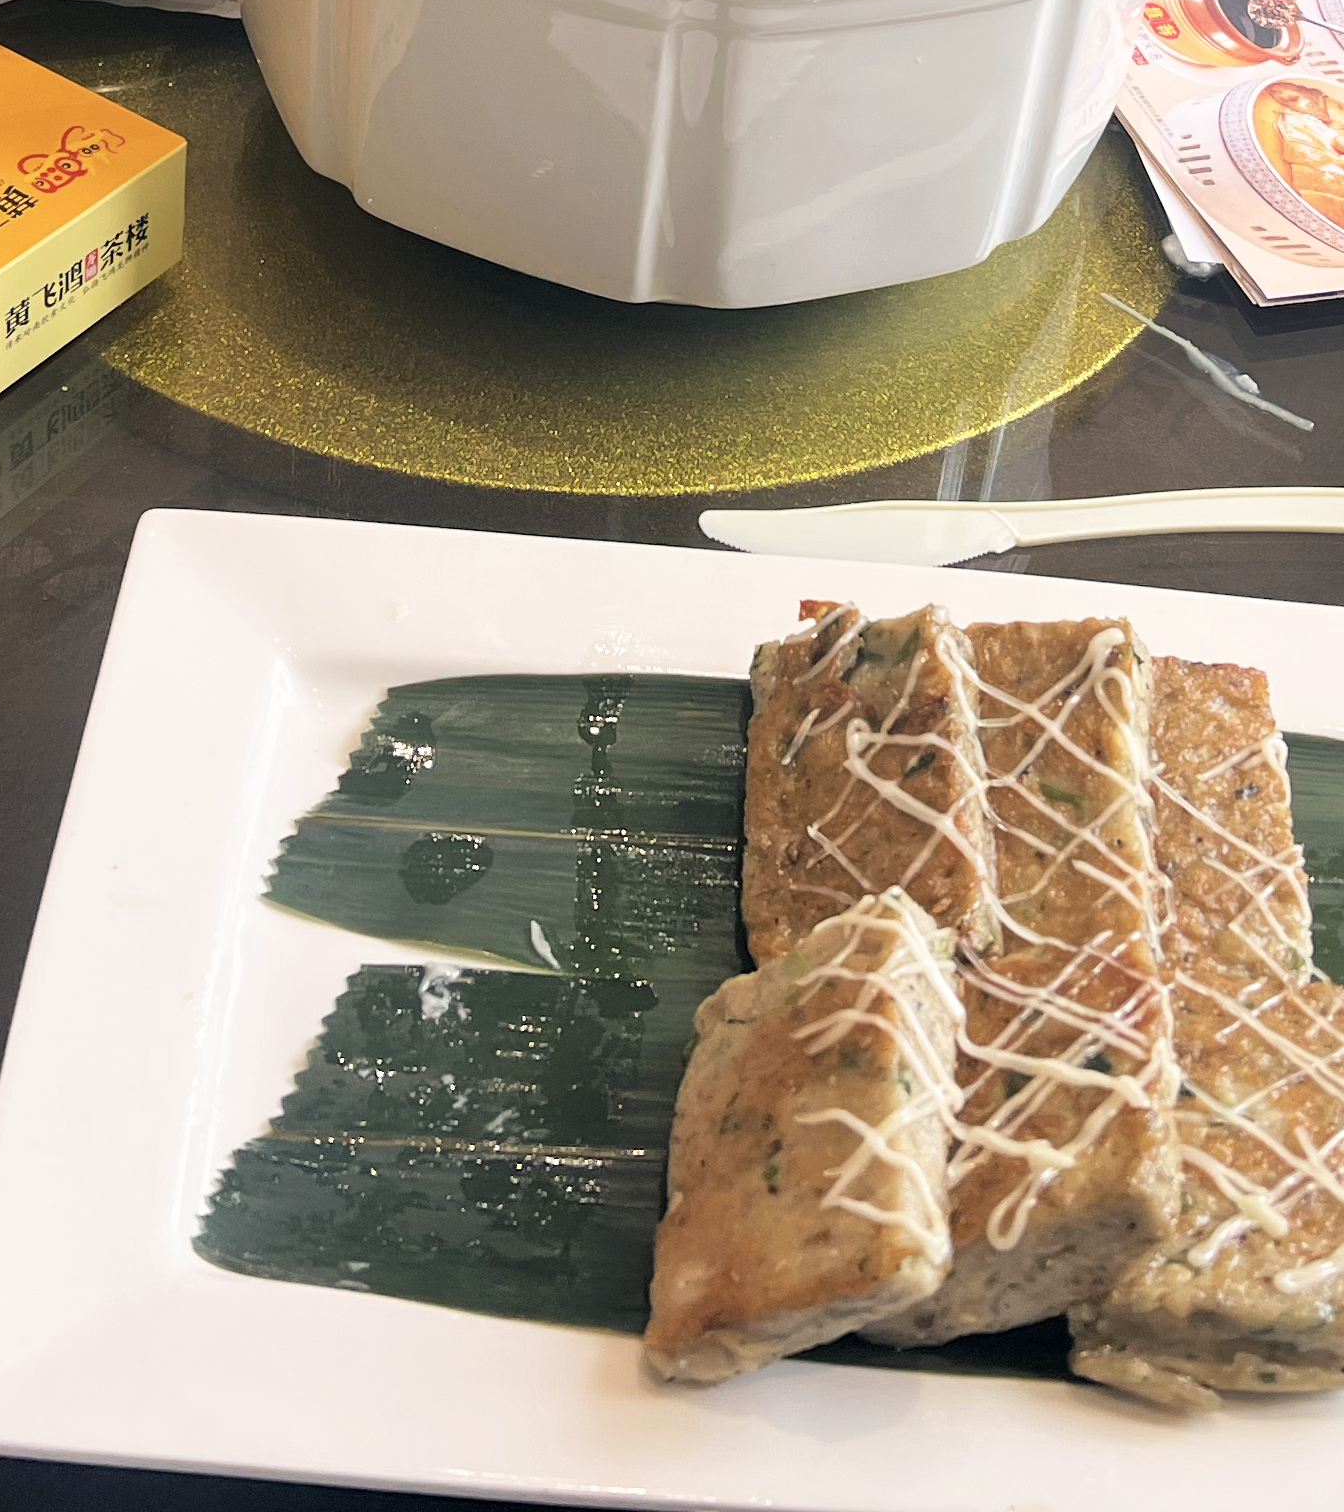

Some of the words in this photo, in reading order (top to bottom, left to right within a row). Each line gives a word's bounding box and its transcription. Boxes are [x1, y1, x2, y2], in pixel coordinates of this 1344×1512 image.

[5, 258, 84, 339] 黄飞鸿
[100, 212, 150, 272] 茶楼
